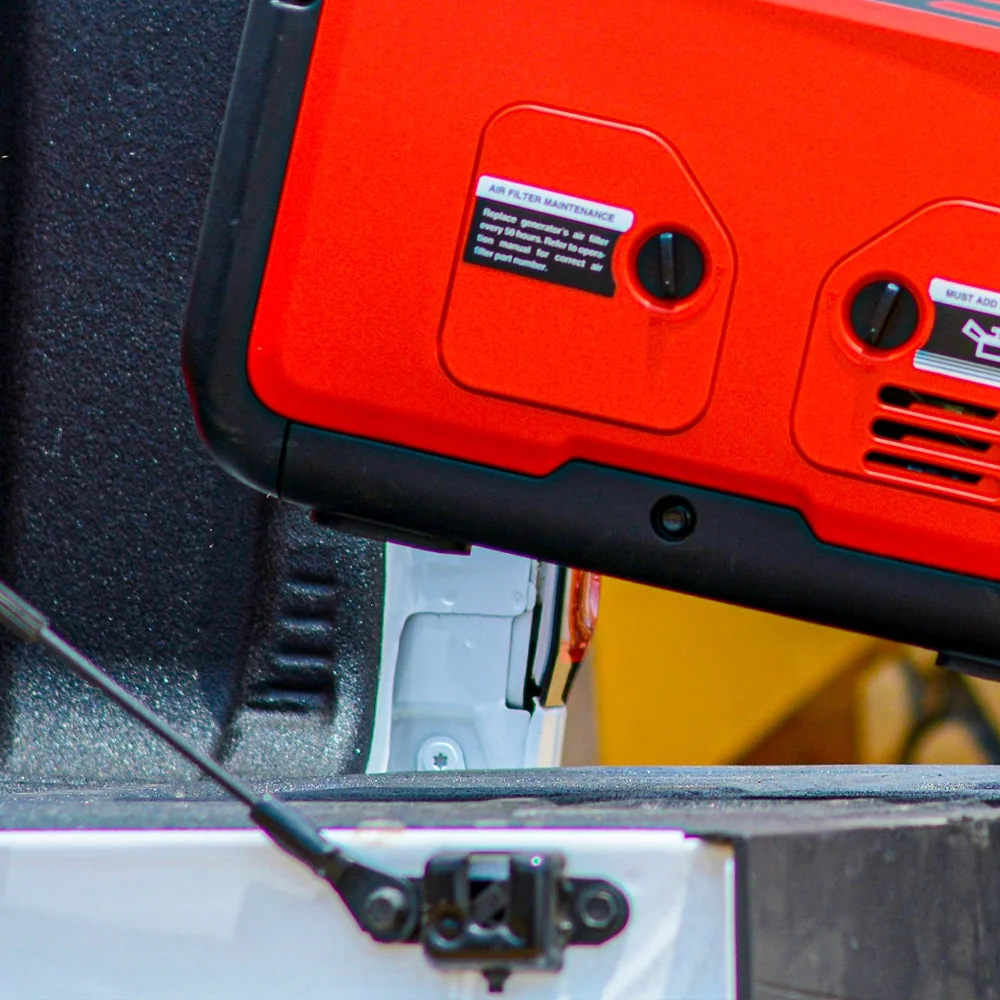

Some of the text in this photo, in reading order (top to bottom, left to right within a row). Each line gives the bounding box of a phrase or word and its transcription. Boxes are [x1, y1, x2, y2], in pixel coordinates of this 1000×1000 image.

[488, 184, 616, 223] AIR FILTER MAINTENANCE
[479, 221, 503, 236] every
[515, 229, 543, 244] hours.
[568, 242, 578, 252] to
[482, 208, 518, 224] Replace
[520, 218, 570, 237] generator's
[572, 230, 586, 241] air
[554, 253, 586, 269] correct
[945, 288, 974, 303] MUST
[975, 297, 998, 308] ADD
